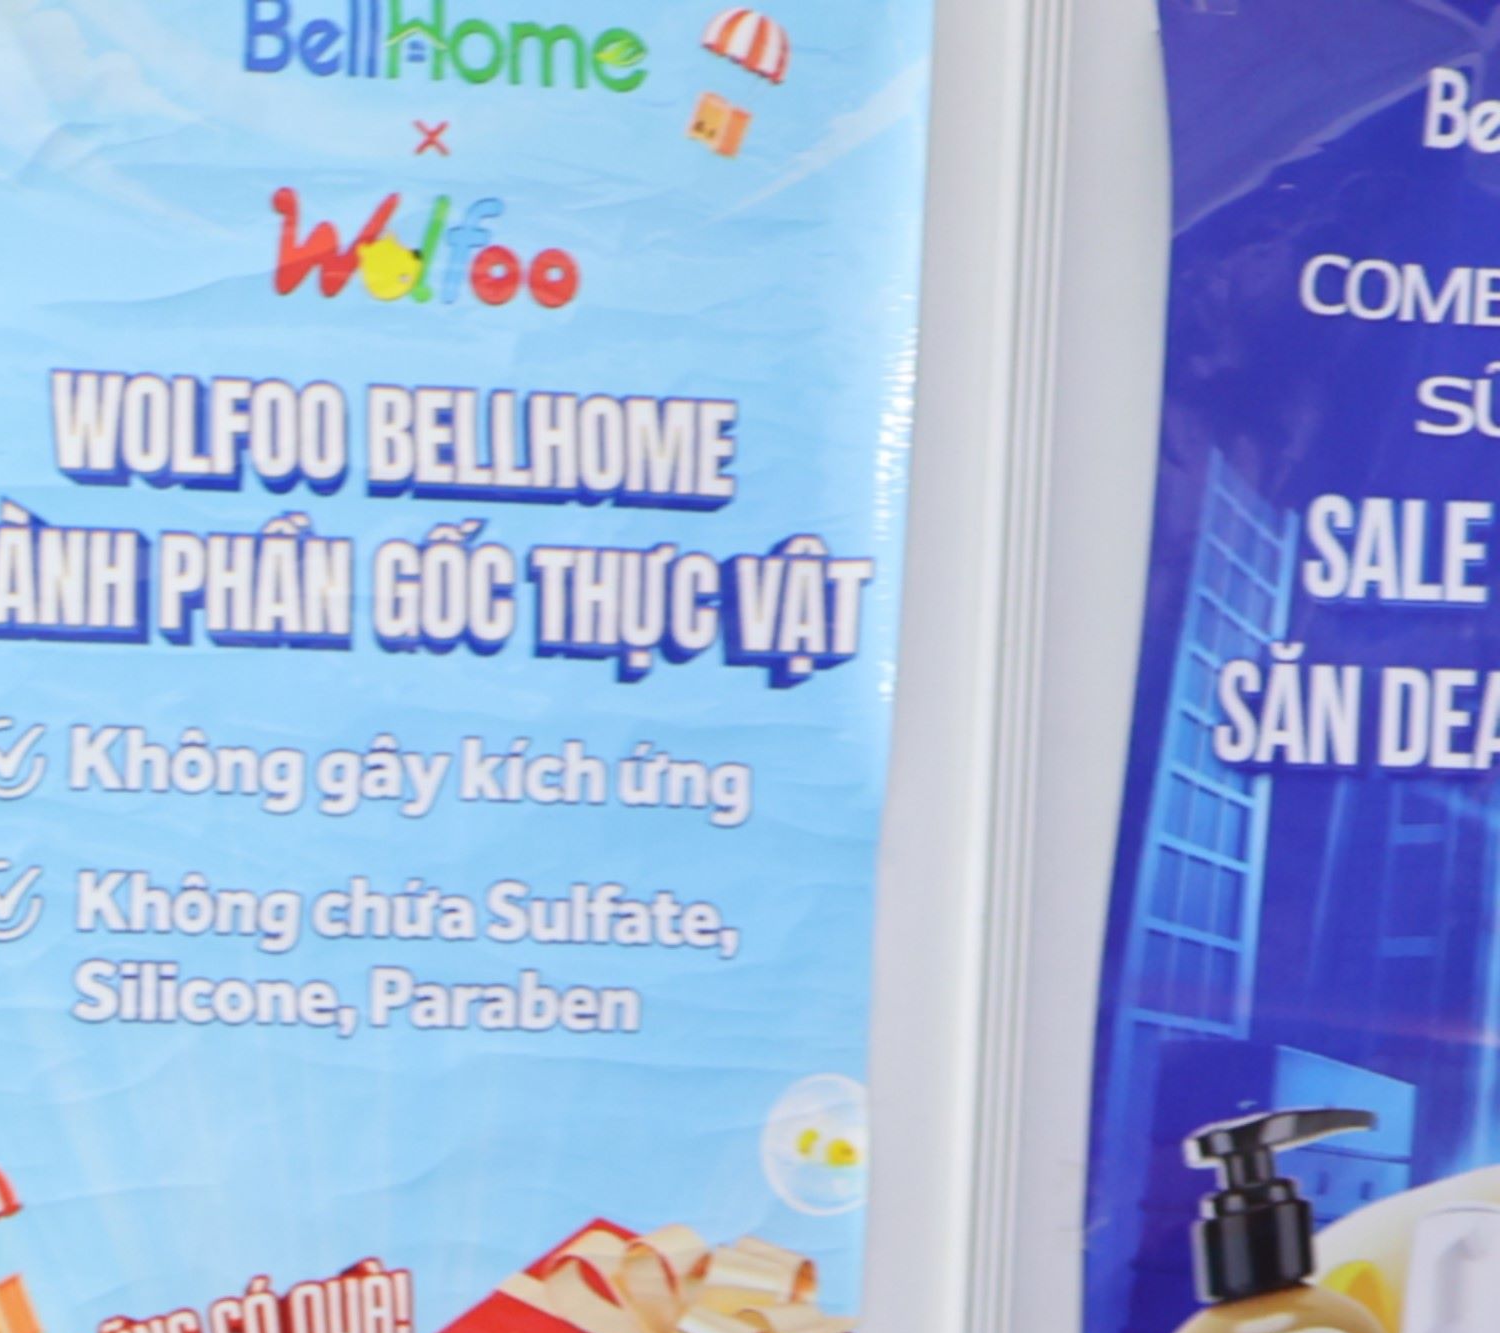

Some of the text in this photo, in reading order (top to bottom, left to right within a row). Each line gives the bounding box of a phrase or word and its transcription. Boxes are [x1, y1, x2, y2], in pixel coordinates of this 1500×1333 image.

[243, 0, 648, 92] BellHome
[271, 186, 580, 308] Wolfoo
[50, 368, 738, 510] WOLFOO BELLHOME
[158, 510, 353, 650] PHẦN
[371, 518, 515, 654] GỐC
[530, 542, 720, 683] THỰC
[724, 534, 874, 689] VẬT
[1304, 492, 1492, 604] SALE
[1214, 641, 1364, 768] SĂN
[68, 722, 754, 828] Không gây kích ứng
[74, 868, 741, 960] Không chứa Sulfate,
[71, 960, 642, 1038] Silicone, Paraben
